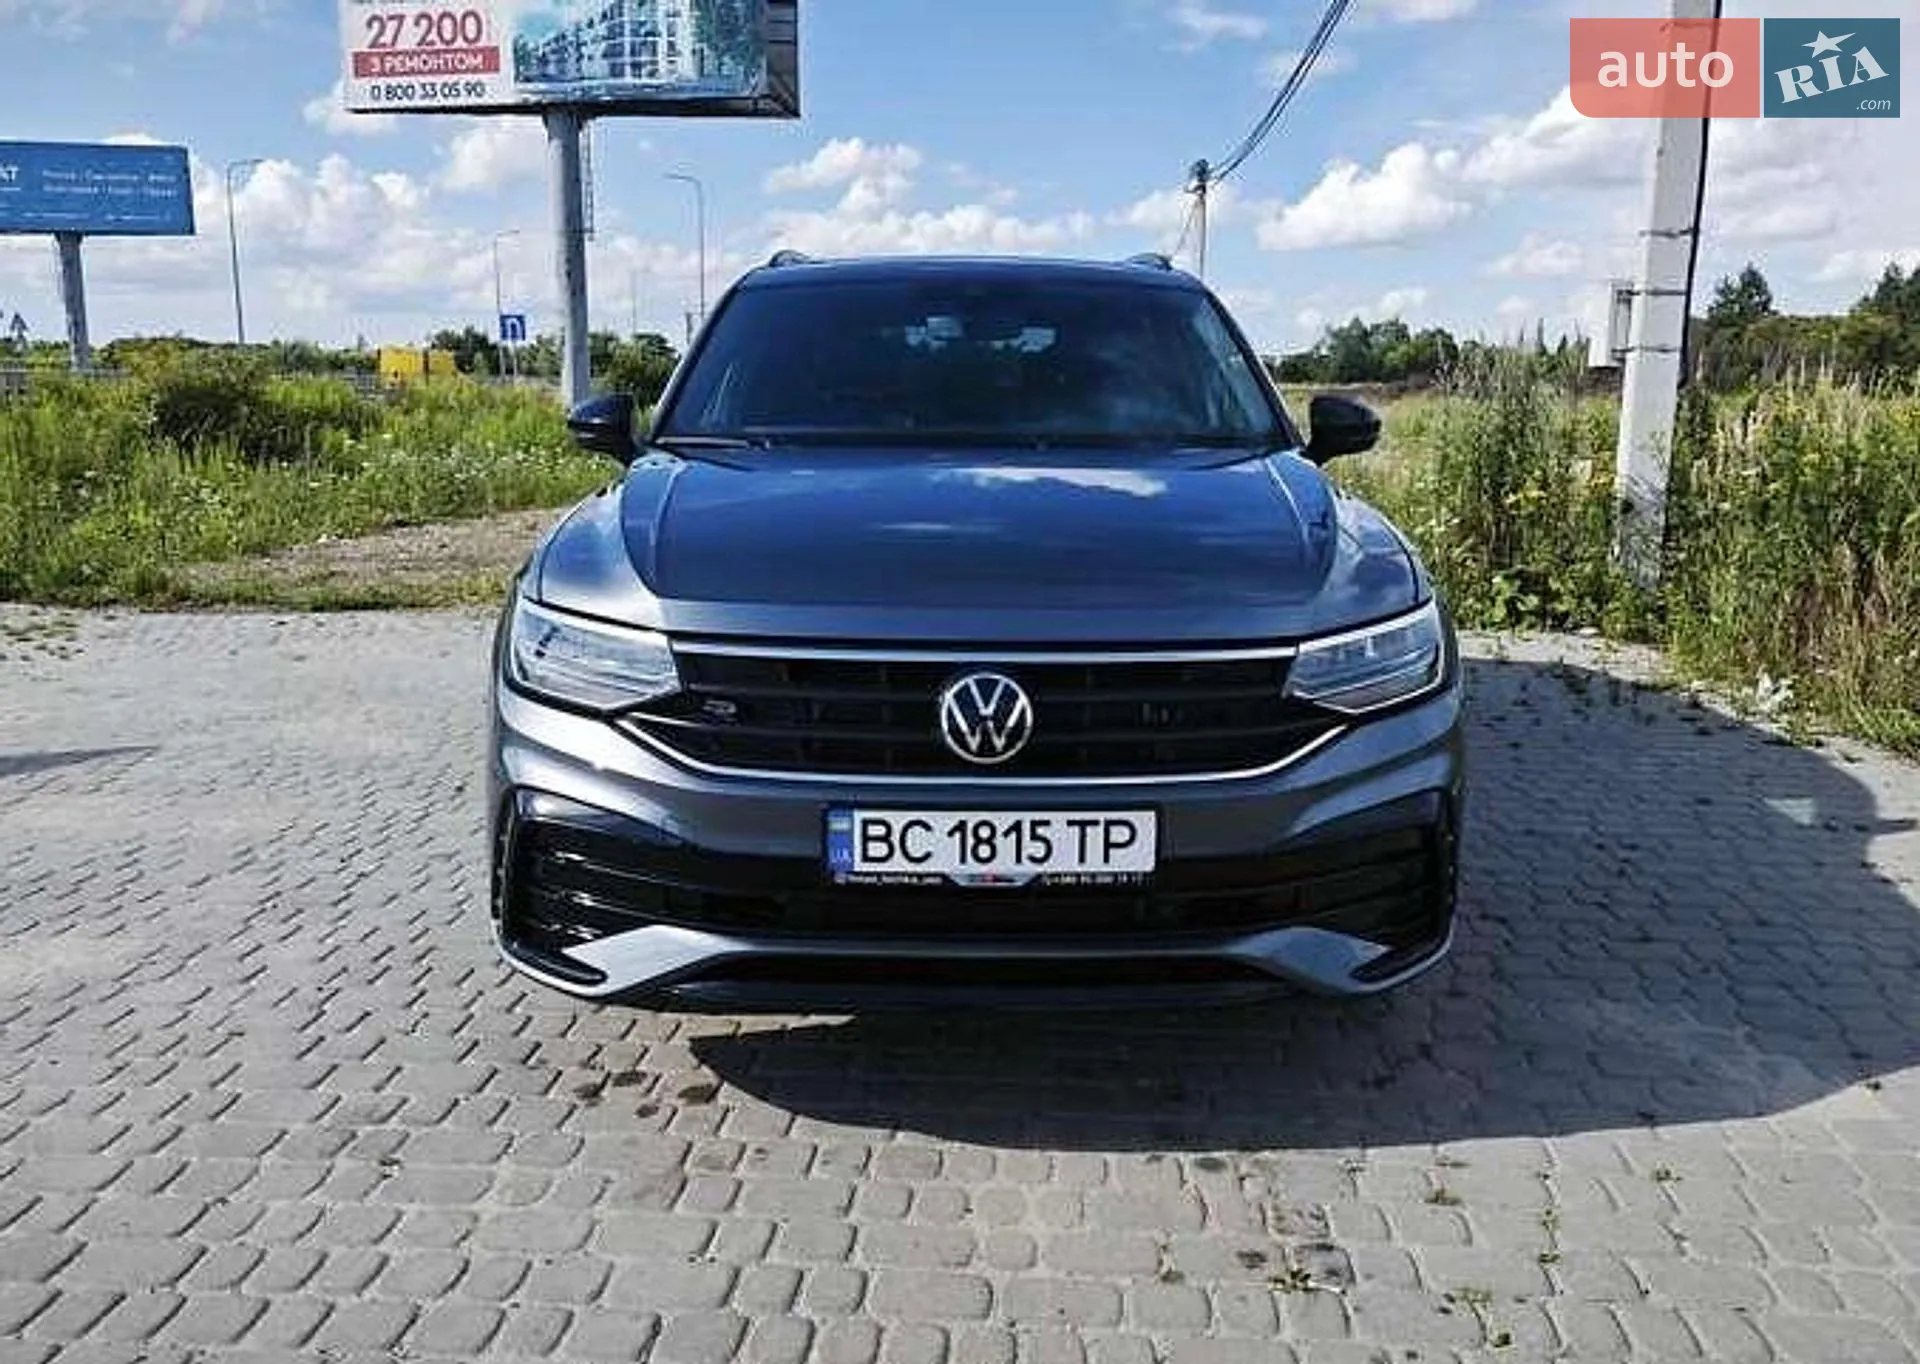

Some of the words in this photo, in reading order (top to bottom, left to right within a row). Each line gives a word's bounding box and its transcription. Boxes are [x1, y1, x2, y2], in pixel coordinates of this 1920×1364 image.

[366, 14, 406, 48] 27
[414, 10, 483, 46] 200
[371, 84, 381, 100] 0
[385, 84, 415, 100] 800
[419, 82, 437, 98] 33
[464, 80, 485, 97] 90
[861, 819, 932, 863] BC
[947, 820, 1053, 864] 1815
[1067, 819, 1137, 864] TP
